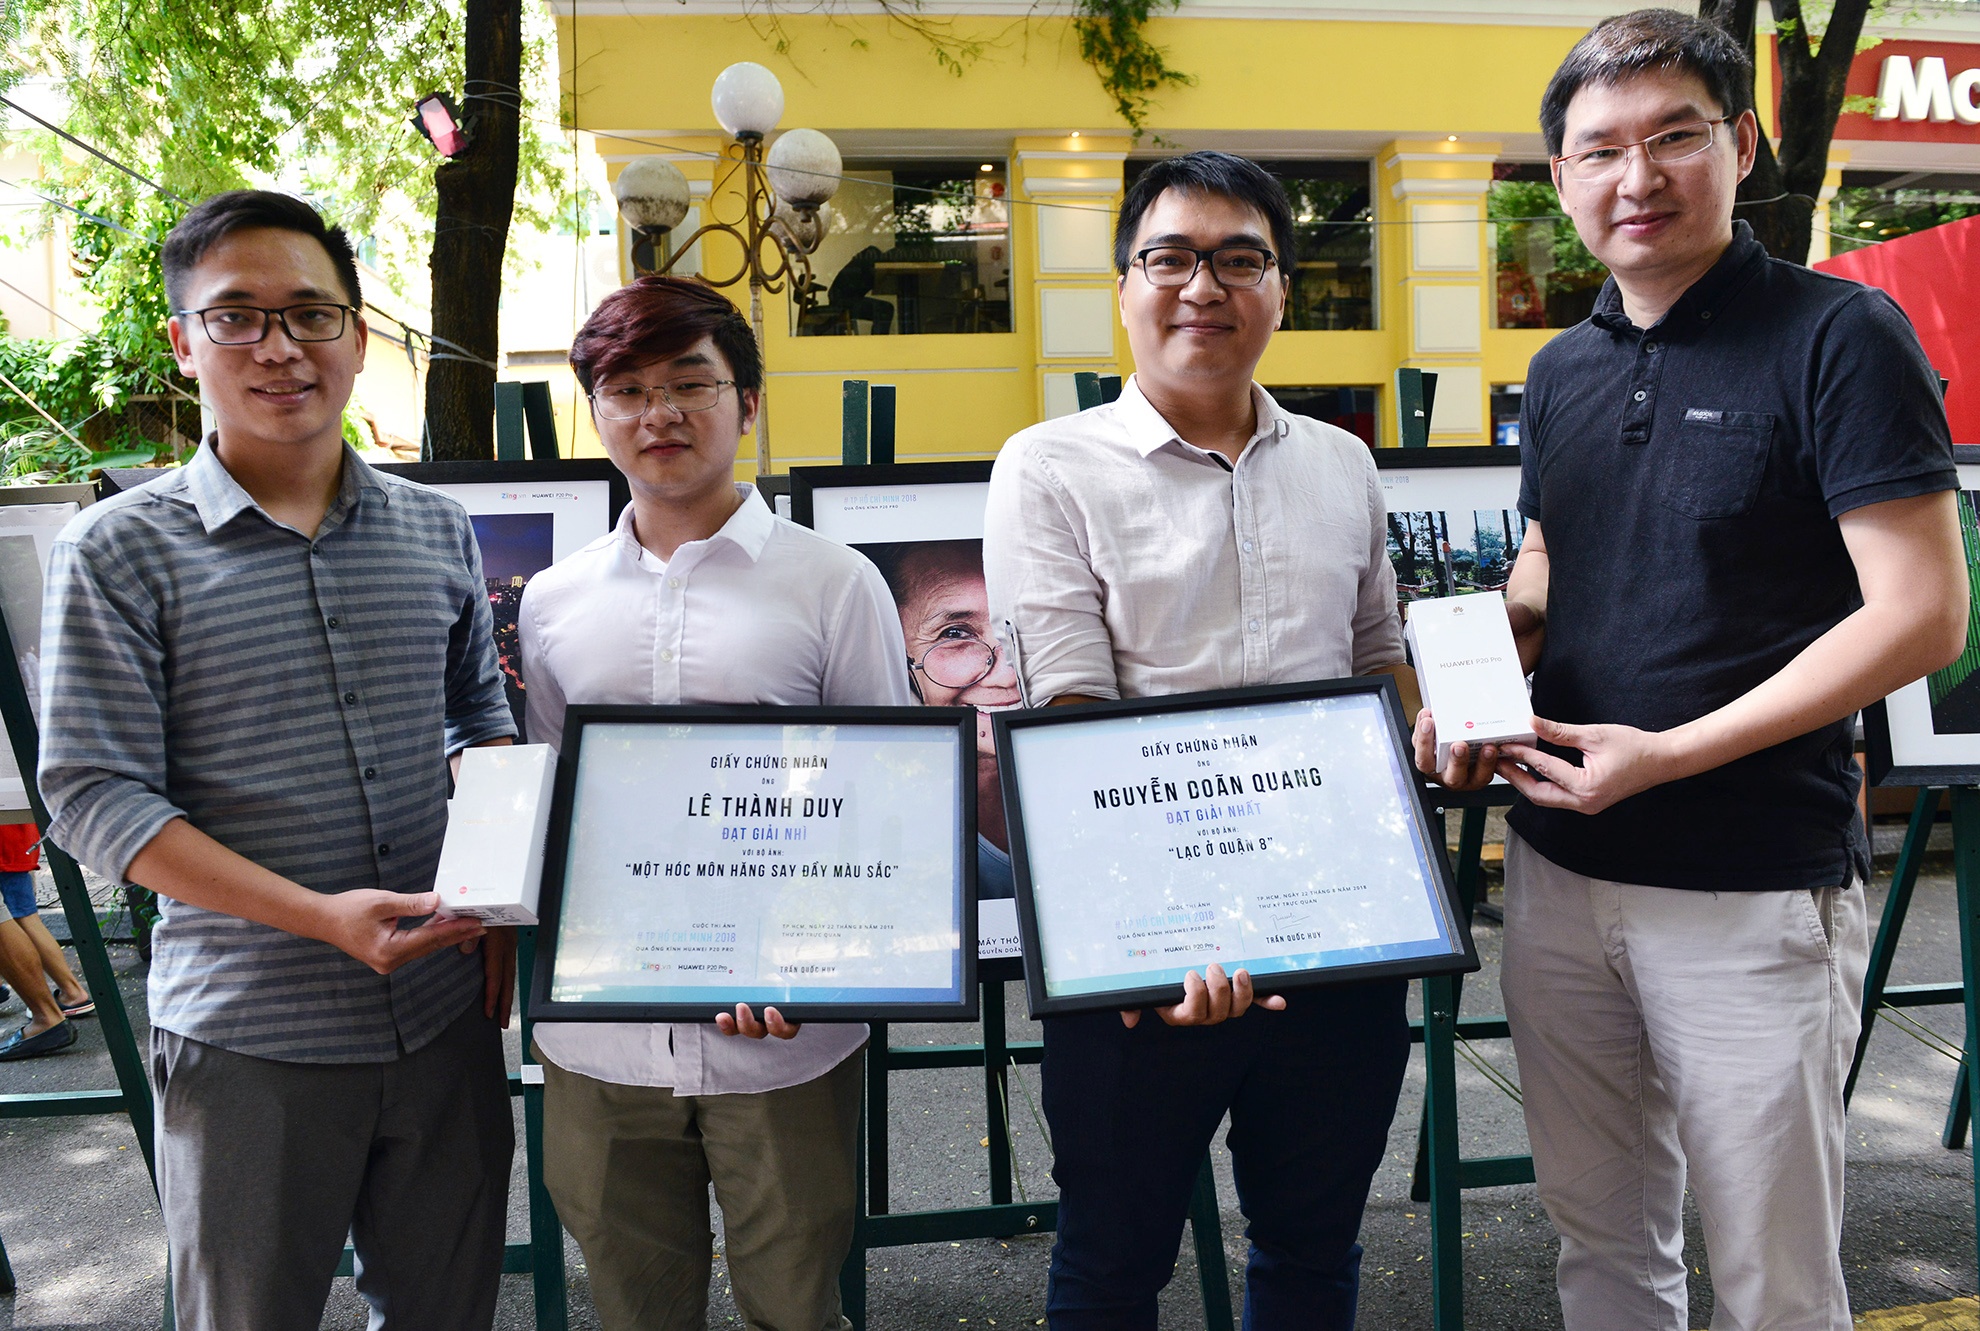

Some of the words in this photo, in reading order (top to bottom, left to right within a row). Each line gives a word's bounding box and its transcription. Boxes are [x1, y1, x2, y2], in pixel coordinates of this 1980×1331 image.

[1873, 55, 1980, 125] Mc
[850, 496, 858, 504] TP
[882, 495, 900, 503] MINH
[901, 494, 917, 502] 2018
[1440, 660, 1474, 668] HUAWEI
[1142, 740, 1171, 758] GIẤY
[1176, 738, 1218, 754] CHỨNG
[1223, 733, 1258, 750] NHẬN
[711, 753, 740, 769] GIẤY
[745, 755, 788, 769] CHỨNG
[1093, 777, 1178, 809] NGUYỄN
[1187, 774, 1244, 800] DOÃN
[1252, 767, 1323, 793] QUANG
[688, 793, 712, 817] LÊ
[722, 793, 792, 818] THÀNH
[803, 798, 844, 818] DUY
[1166, 810, 1191, 825] ĐẠT
[1196, 804, 1223, 821] GIẢI
[1227, 799, 1262, 817] NHẤT
[722, 827, 747, 842] ĐẠT
[752, 824, 779, 840] GIẢI
[784, 826, 807, 840] NHÌ
[1206, 840, 1215, 856] Ở
[1219, 838, 1255, 854] QUẬN
[665, 861, 691, 877] HÓC
[696, 861, 724, 877] MÔN
[730, 861, 765, 877] HĂNG
[771, 864, 796, 877] SAY
[802, 861, 827, 877] ĐẦY
[833, 862, 861, 878] MÀU
[1167, 914, 1191, 924] MINH
[1193, 911, 1215, 921] 2018
[645, 931, 655, 941] TP
[689, 932, 713, 942] MINH
[714, 932, 736, 943] 2018
[1287, 932, 1305, 941] QUỐC
[1307, 932, 1321, 940] HUY
[1164, 945, 1191, 953] HUAWEI
[801, 965, 819, 973] QUỐC
